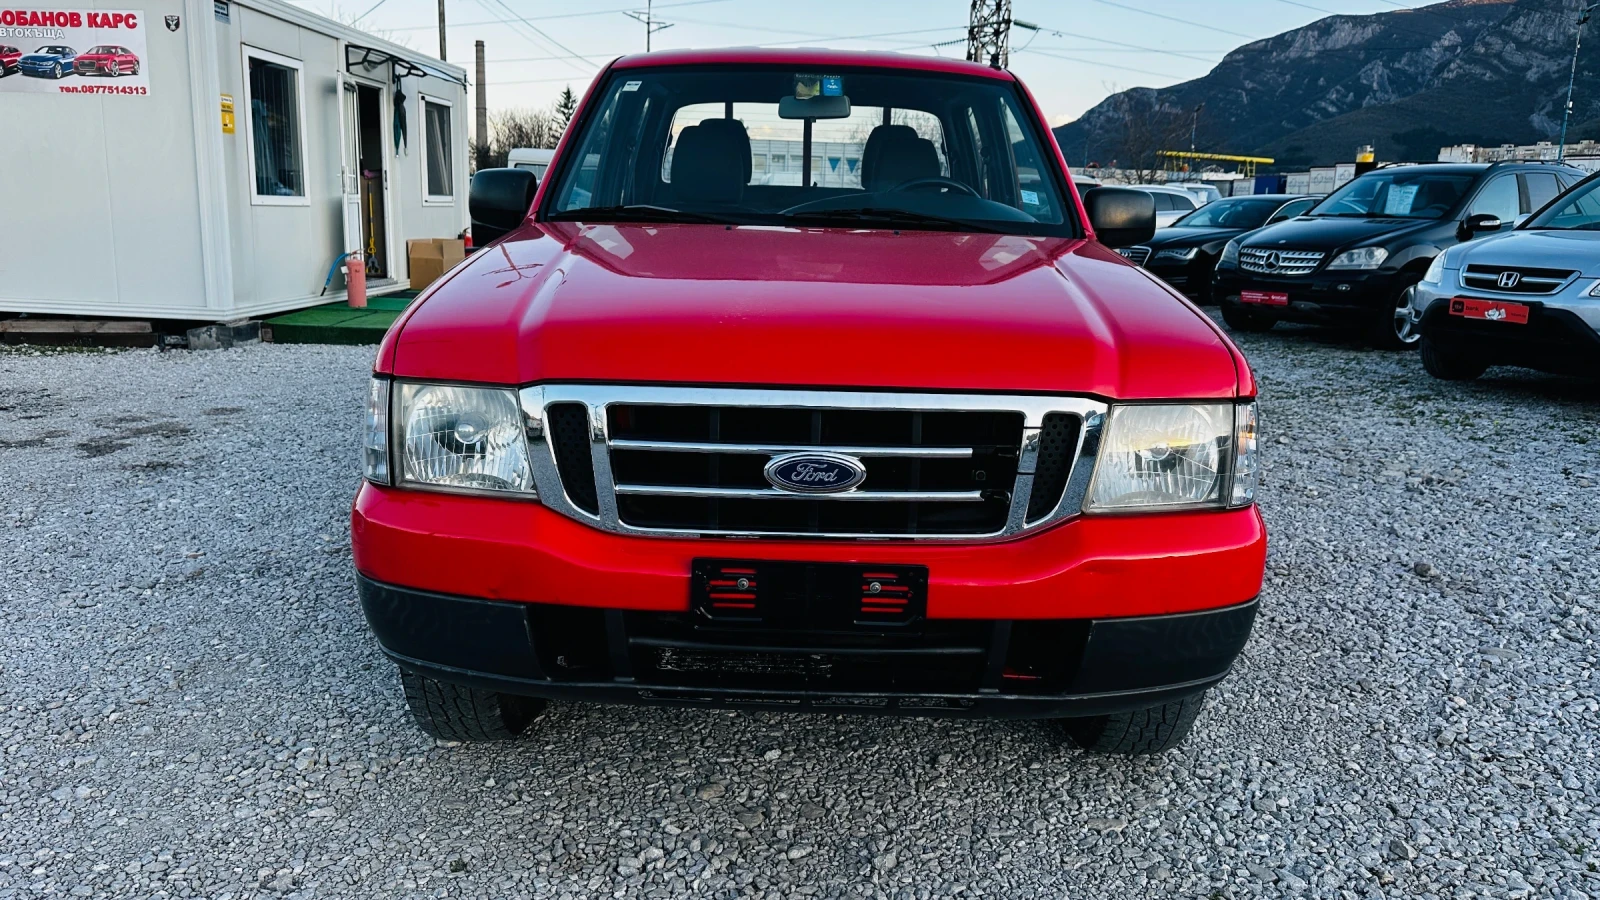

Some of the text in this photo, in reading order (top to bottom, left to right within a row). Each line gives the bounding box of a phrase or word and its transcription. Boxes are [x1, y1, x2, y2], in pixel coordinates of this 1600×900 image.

[0, 10, 137, 29] ОБАНОВ КАРС
[59, 85, 147, 95] тел.0877514313
[791, 462, 839, 482] Ford
